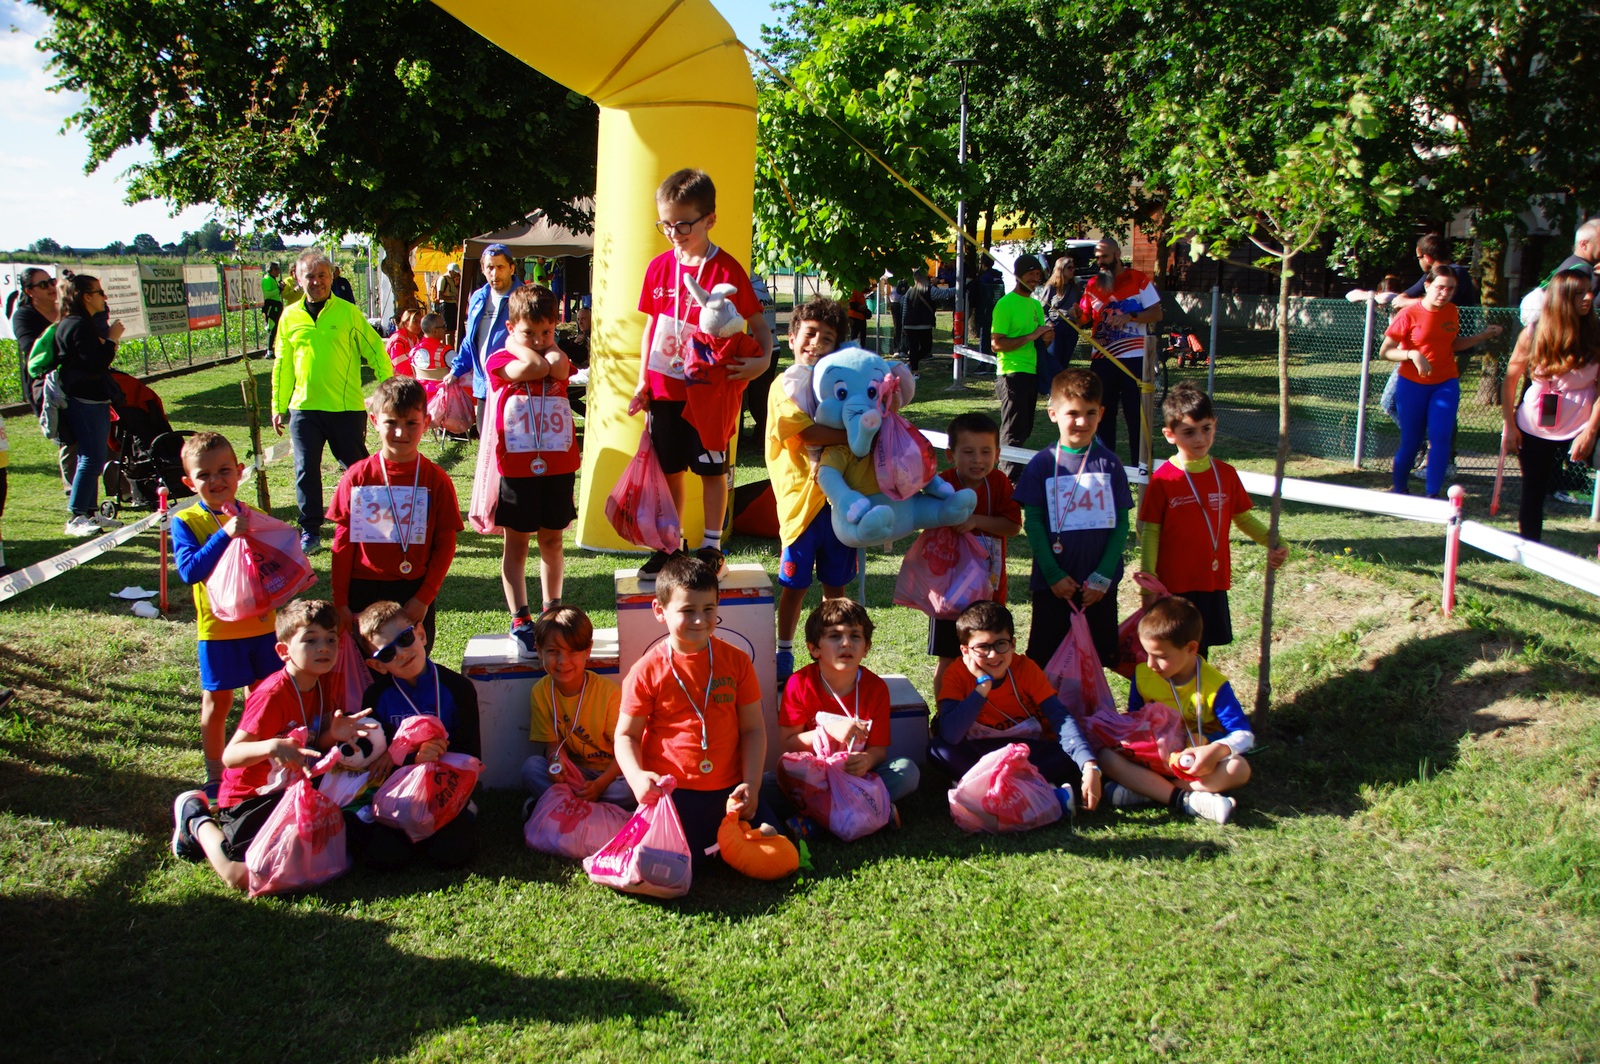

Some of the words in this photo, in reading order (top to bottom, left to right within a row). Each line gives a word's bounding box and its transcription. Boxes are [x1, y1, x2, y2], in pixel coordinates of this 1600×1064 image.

[519, 411, 564, 434] 169
[1062, 489, 1105, 513] 341
[366, 502, 415, 525] 342
